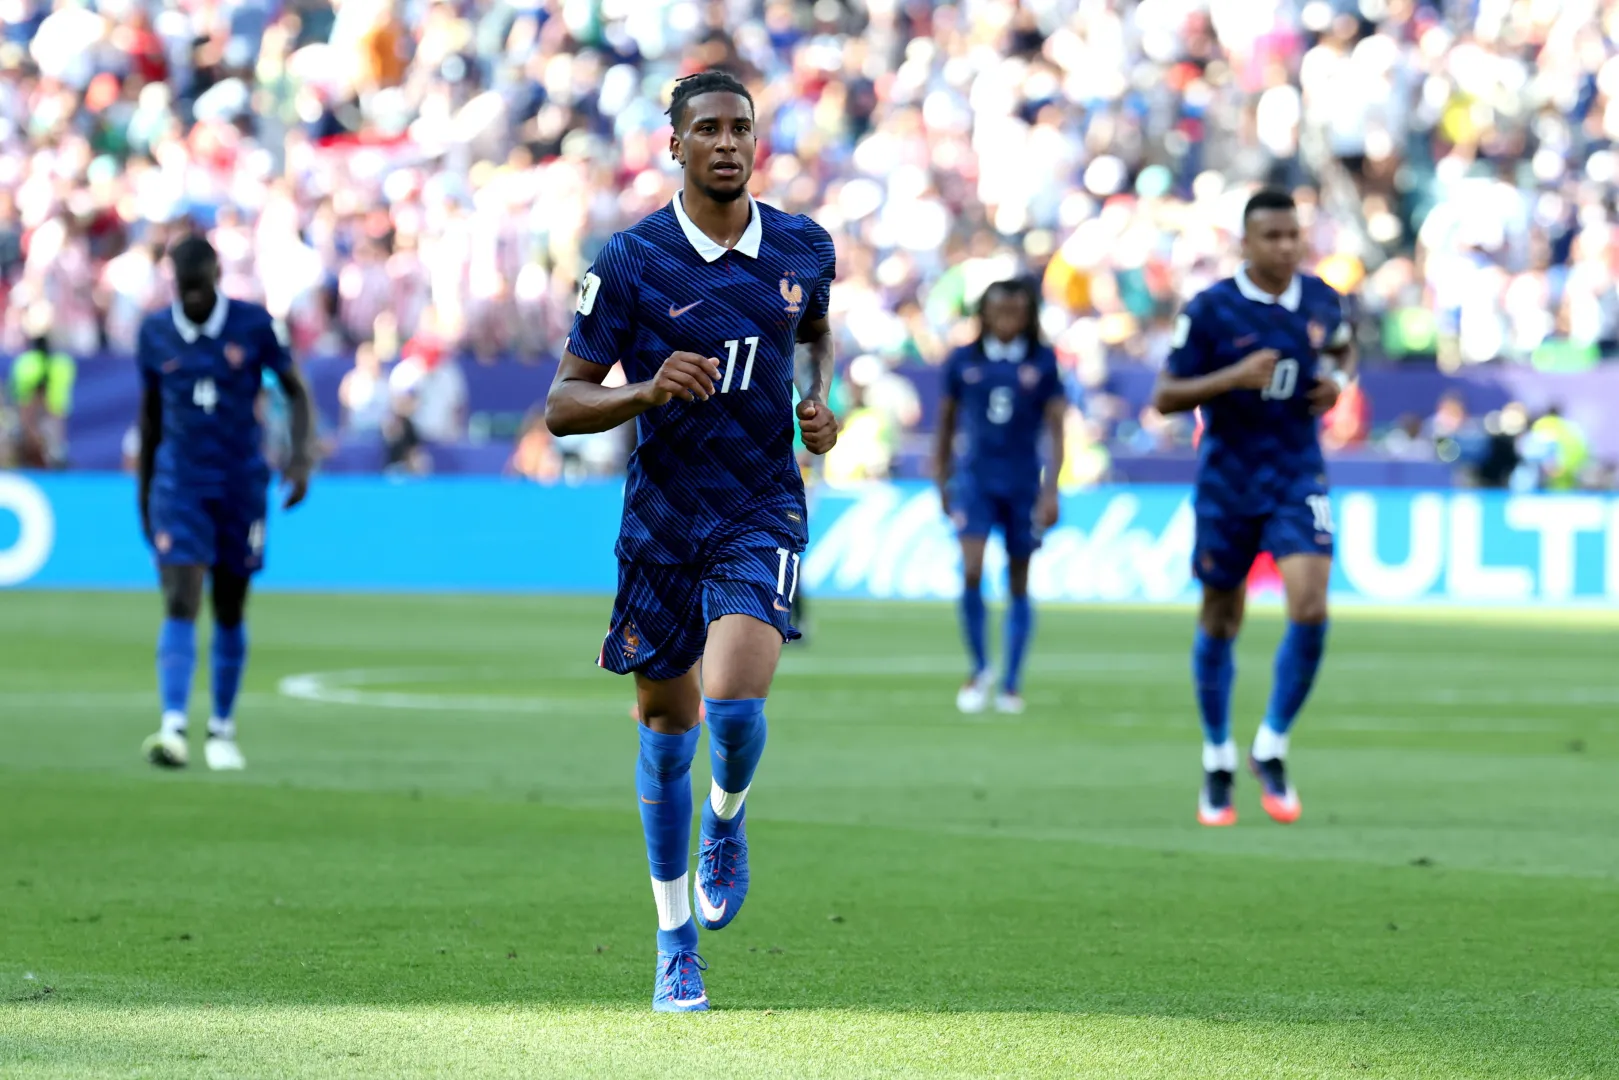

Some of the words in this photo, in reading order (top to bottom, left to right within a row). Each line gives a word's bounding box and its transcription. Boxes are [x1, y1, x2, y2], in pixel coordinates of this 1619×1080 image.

[721, 336, 759, 393] 11
[1261, 358, 1299, 401] 0
[193, 377, 217, 414] 4
[776, 547, 799, 603] 11
[1340, 492, 1619, 602] ULT
